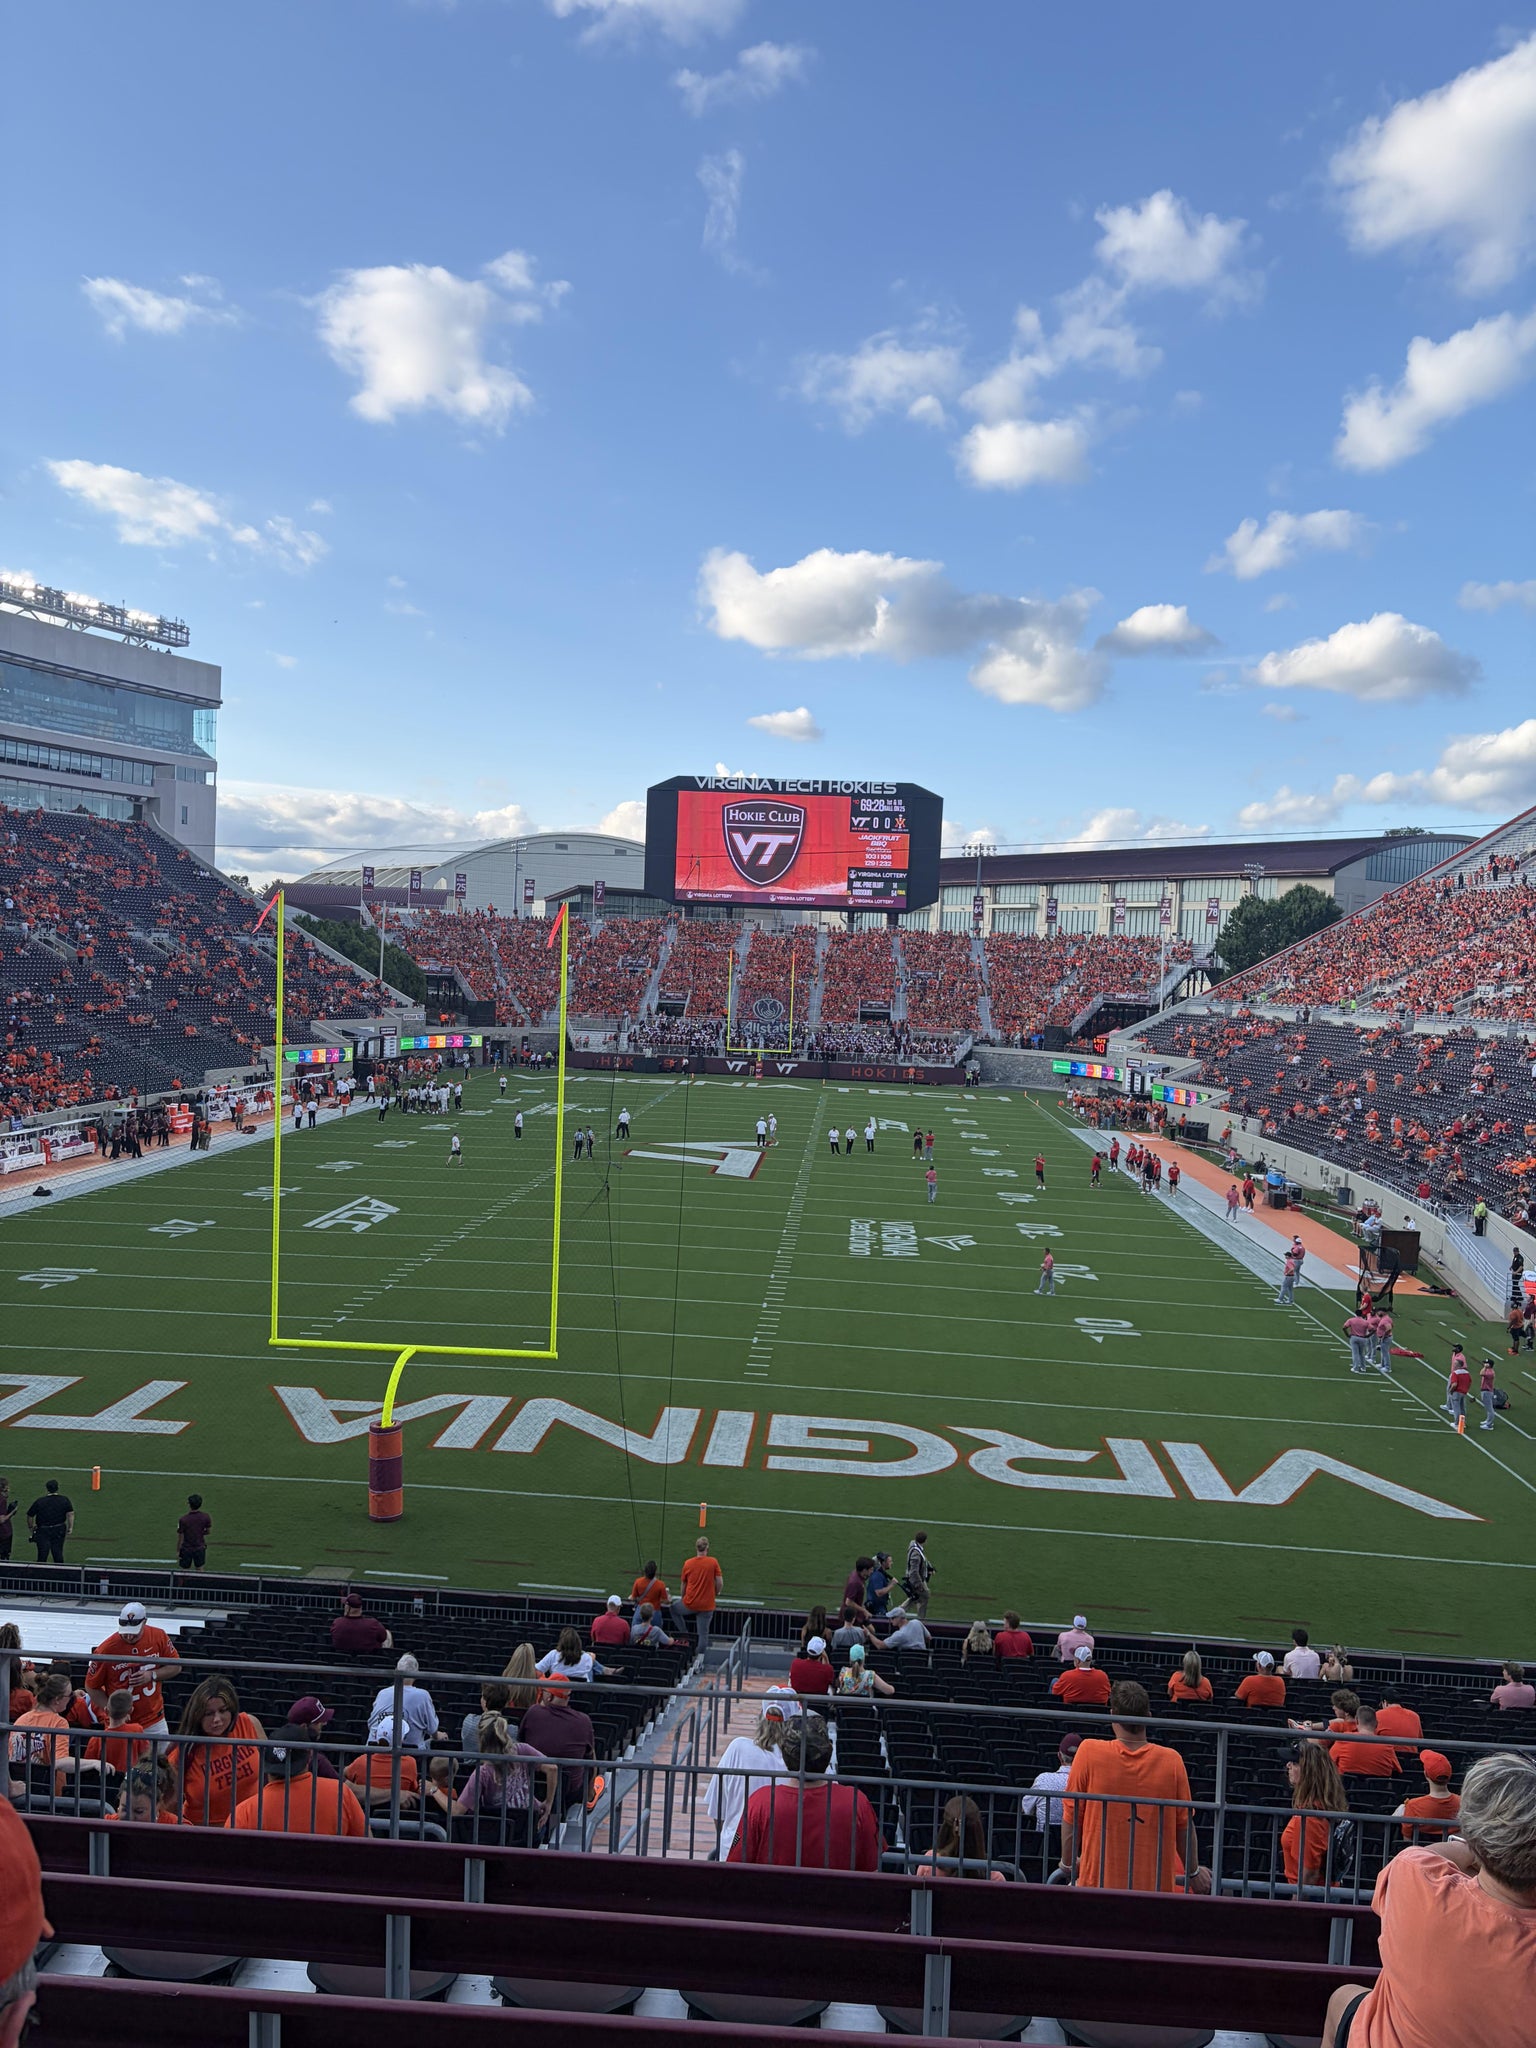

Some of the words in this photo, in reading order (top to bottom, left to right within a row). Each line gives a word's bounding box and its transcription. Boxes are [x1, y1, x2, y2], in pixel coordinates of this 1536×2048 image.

[694, 776, 773, 792] VIRGINIA
[775, 779, 822, 793] TECH
[829, 781, 897, 795] HOKIES
[860, 798, 885, 812] 69:28
[851, 816, 871, 828] VT
[873, 817, 879, 829] 0
[884, 817, 891, 829] 0
[730, 832, 798, 866] VT
[743, 1021, 791, 1034] Allstate
[726, 1061, 748, 1072] VT
[776, 1063, 798, 1074] VT
[148, 1218, 216, 1233] 20
[1016, 1222, 1064, 1236] 30
[18, 1267, 98, 1285] 10
[1074, 1317, 1142, 1337] 10
[271, 1384, 1490, 1522] VIRGINIA
